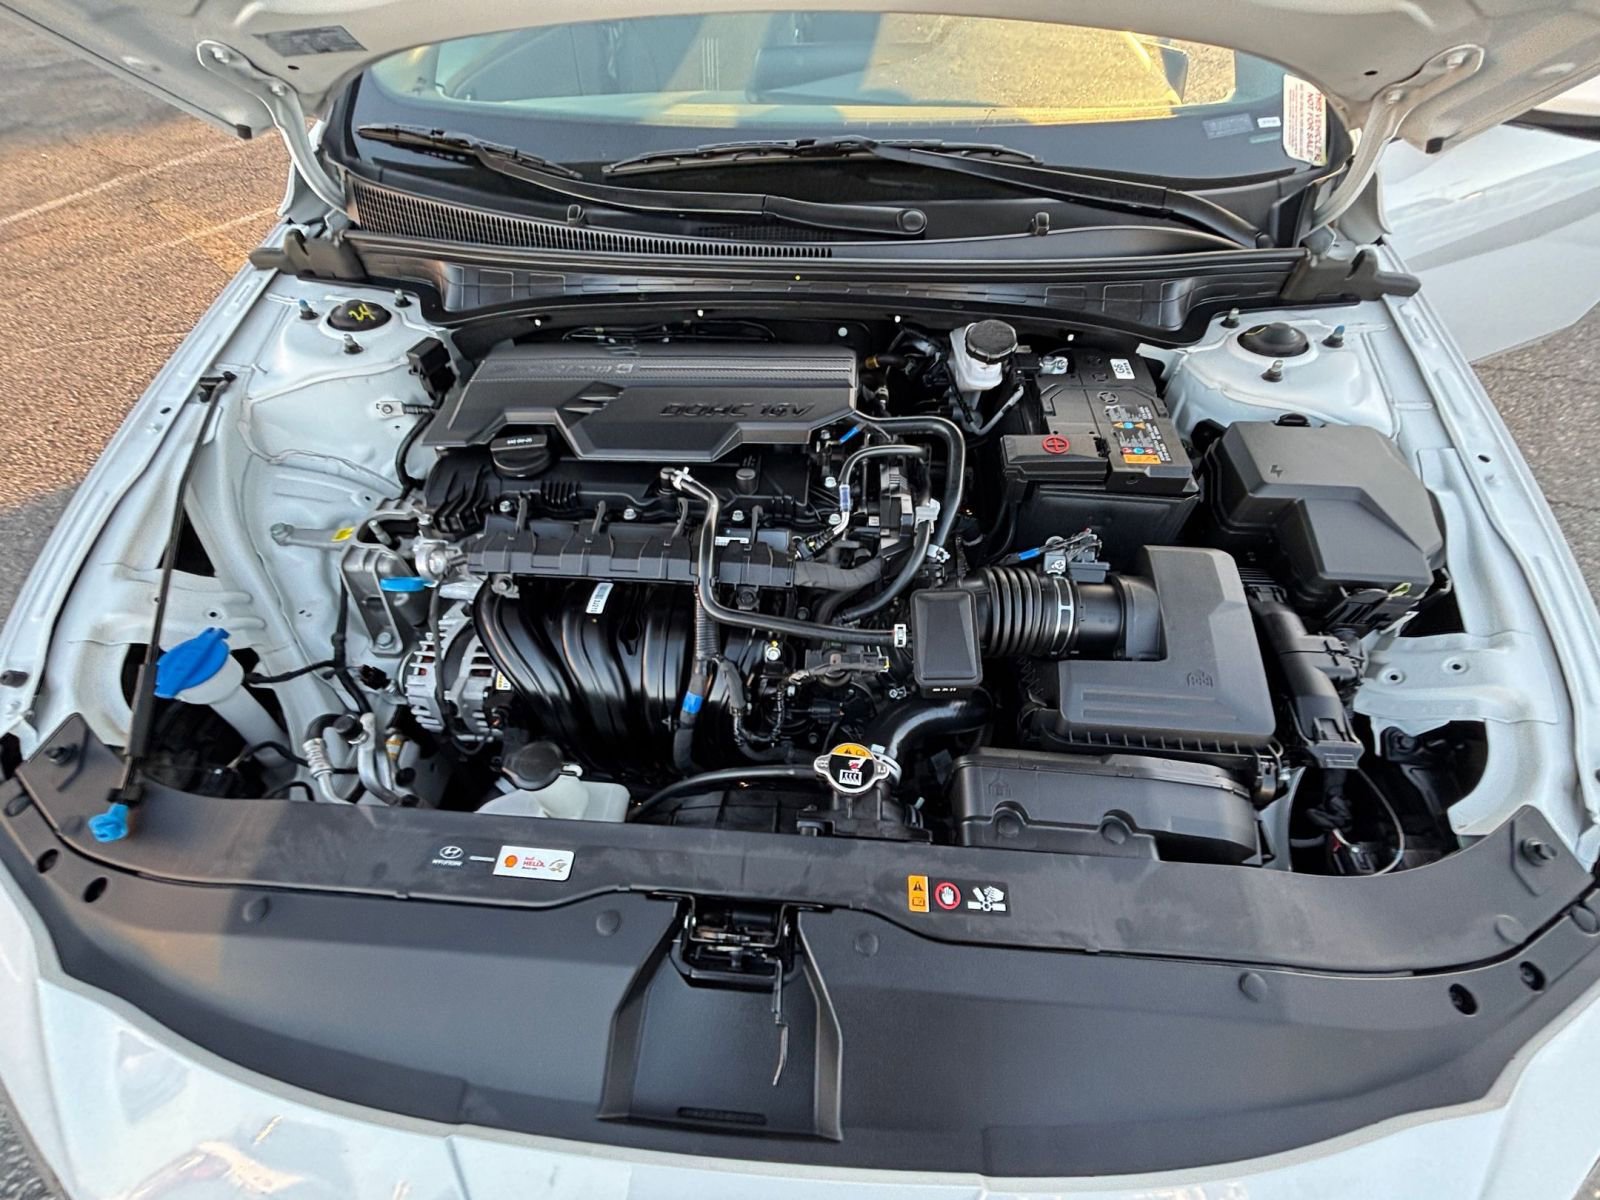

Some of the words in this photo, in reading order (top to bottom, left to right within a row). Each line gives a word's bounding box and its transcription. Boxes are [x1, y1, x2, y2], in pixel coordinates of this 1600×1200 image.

[1306, 91, 1315, 110] NOT
[1306, 111, 1315, 131] FOR
[1314, 113, 1323, 151] VEHICLE
[1306, 132, 1315, 156] SALE
[659, 402, 752, 418] DOHC
[758, 402, 815, 418] 16V
